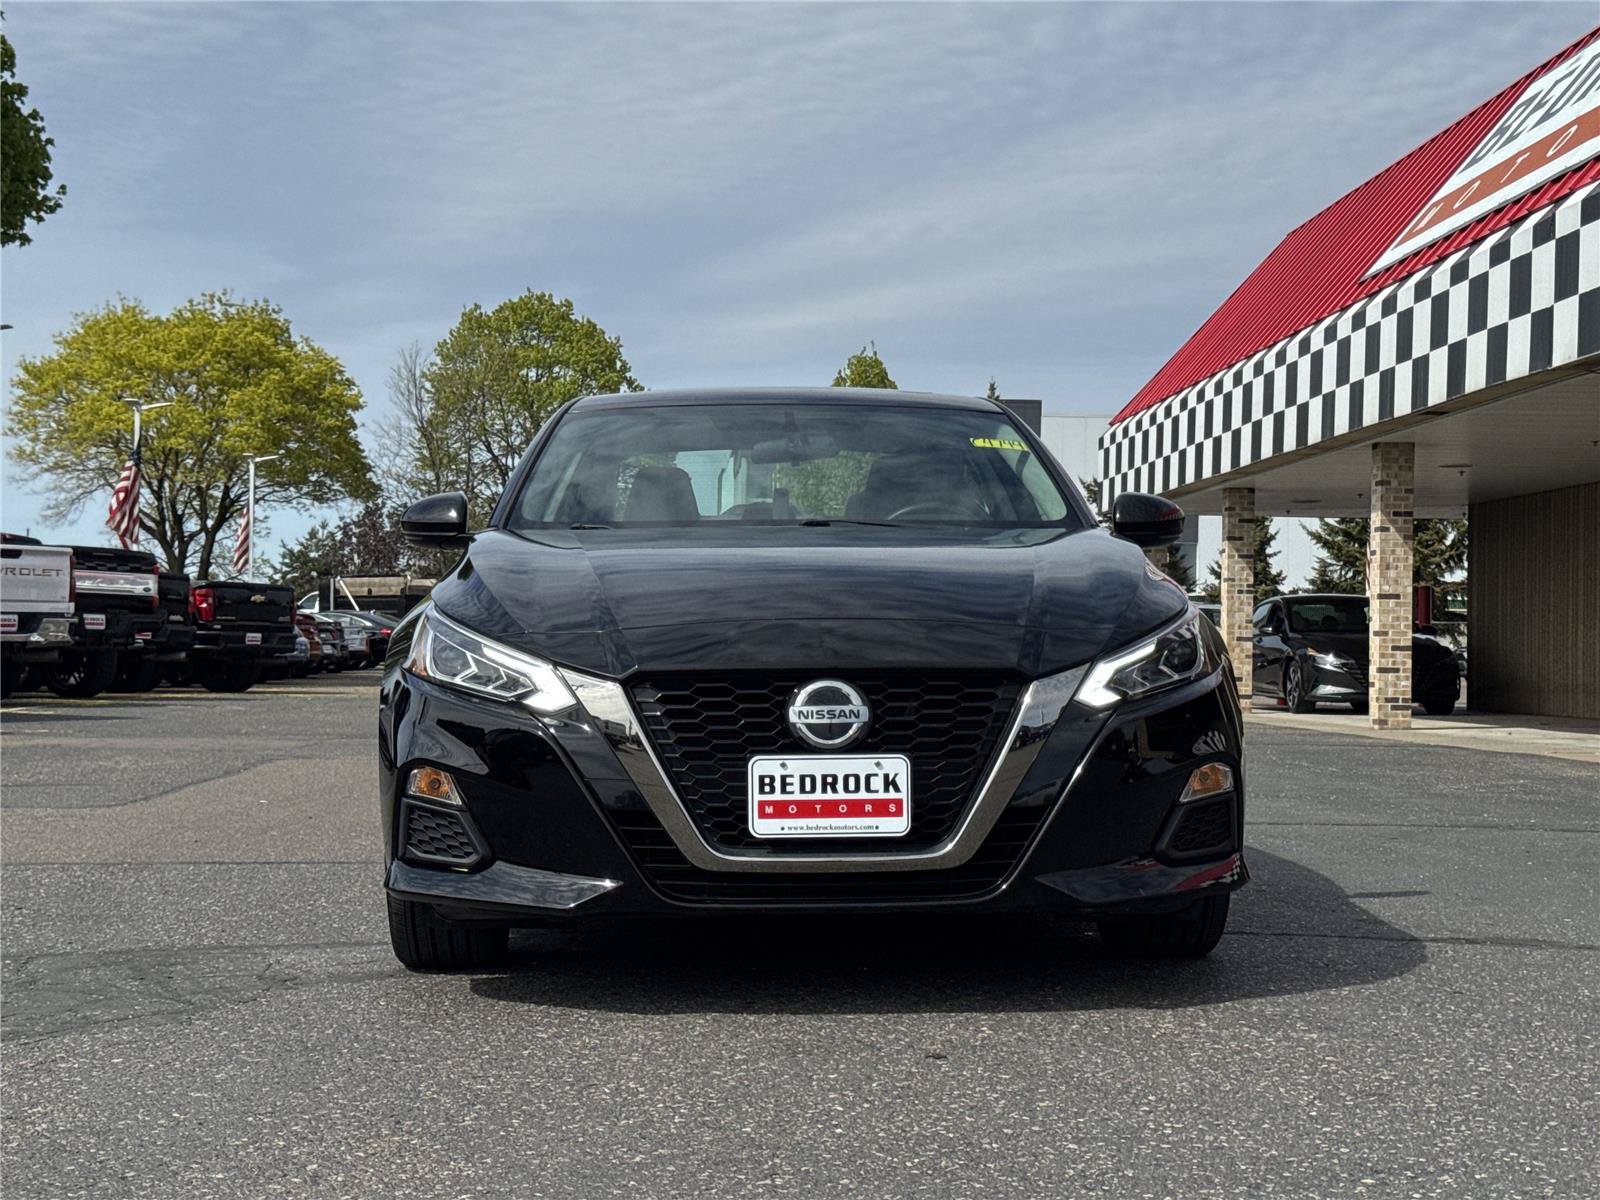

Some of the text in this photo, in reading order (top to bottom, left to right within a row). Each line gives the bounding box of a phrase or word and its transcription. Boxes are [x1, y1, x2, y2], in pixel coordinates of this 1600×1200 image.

[797, 709, 860, 720] NISSAN
[758, 773, 902, 795] BEDROCK
[764, 803, 897, 814] MOTORS
[787, 823, 875, 831] www.bedrockmotors.com
